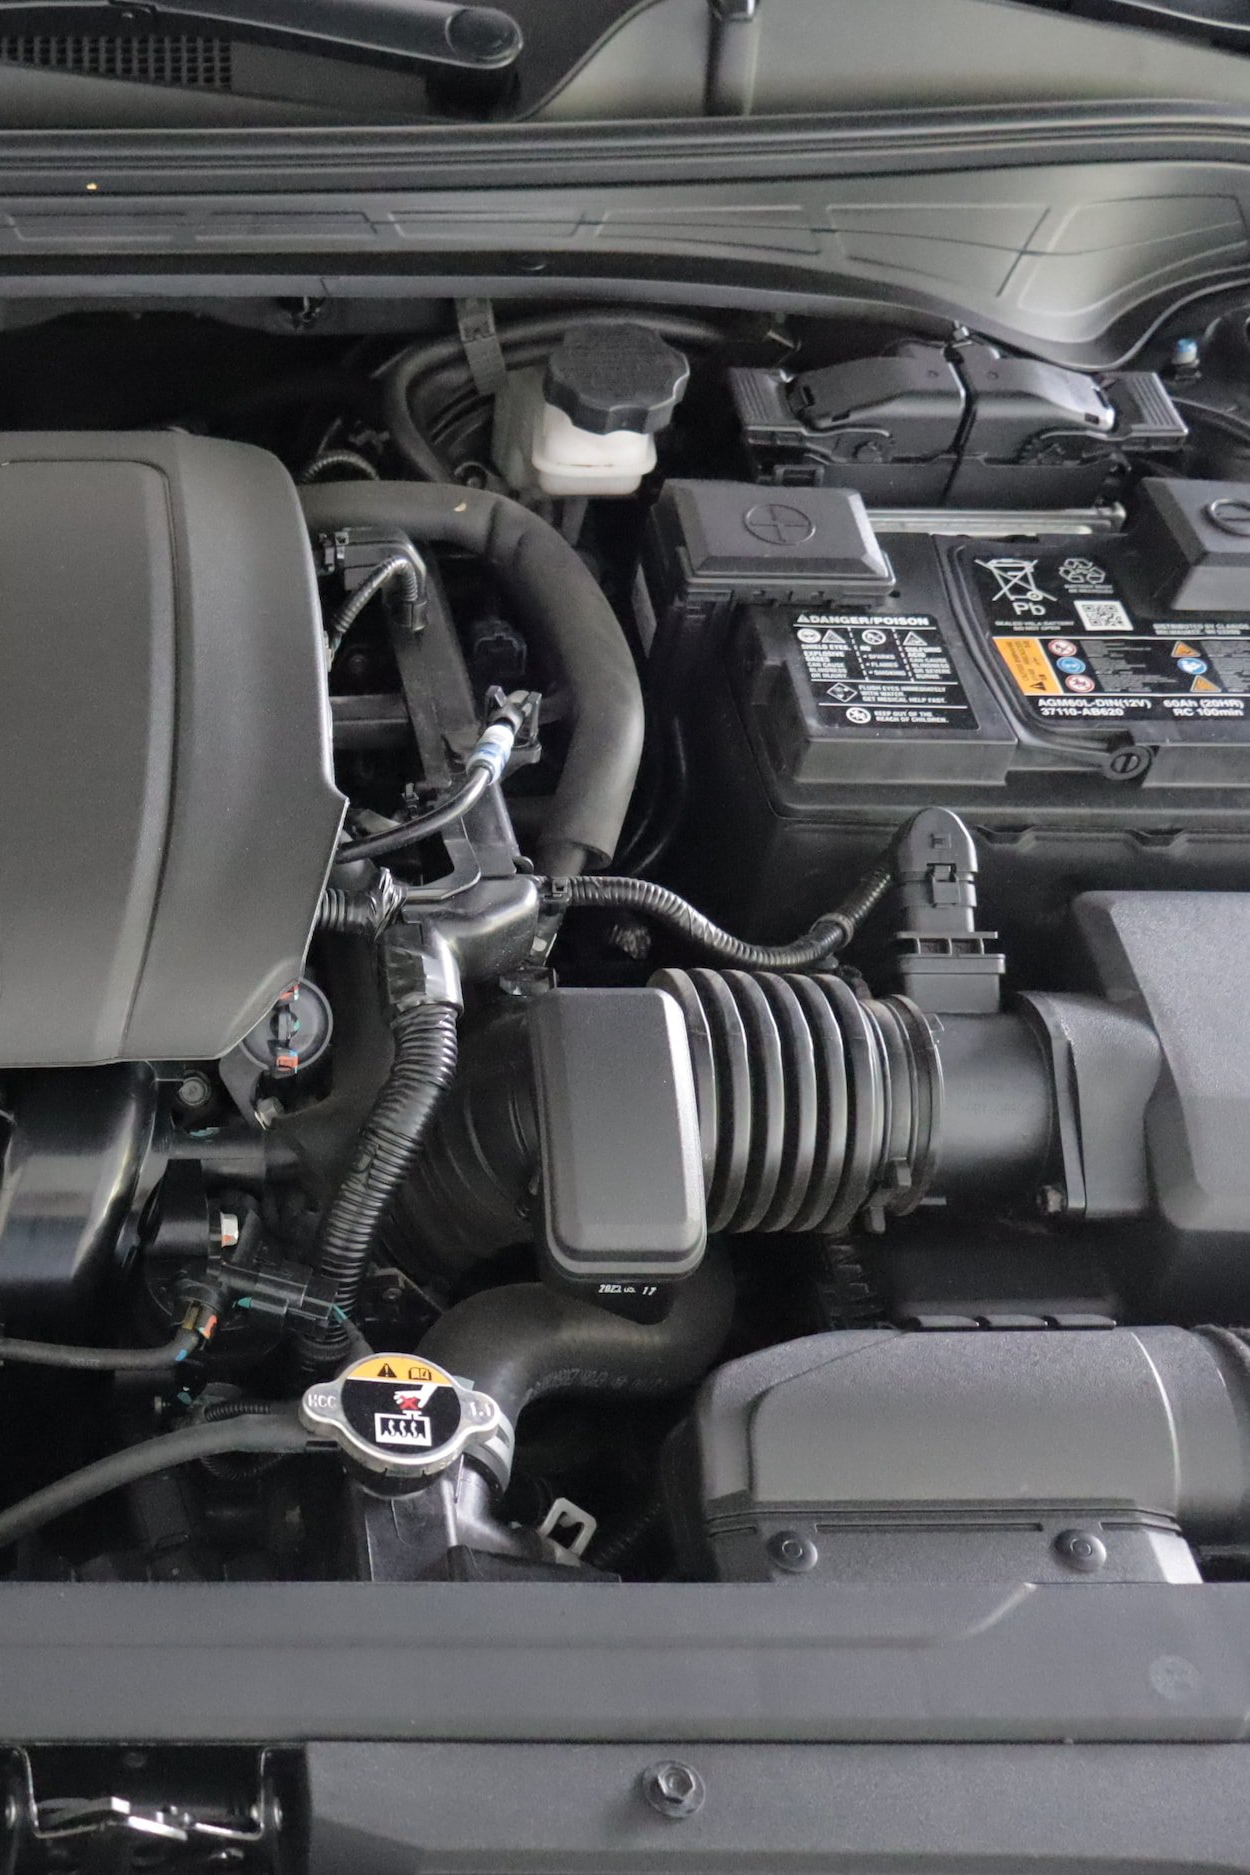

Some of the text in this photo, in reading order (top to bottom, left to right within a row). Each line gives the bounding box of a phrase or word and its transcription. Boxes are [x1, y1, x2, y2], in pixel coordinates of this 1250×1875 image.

[1012, 602, 1046, 615] Pb
[808, 614, 930, 626] DANGER/POISON
[1038, 698, 1152, 709] AGM60L-DIN(12V)
[1162, 698, 1245, 709] 60Ah (20HR)
[1040, 707, 1125, 717] 37110-AB620
[1172, 707, 1244, 717] RC 100min
[307, 1393, 336, 1409] HCC
